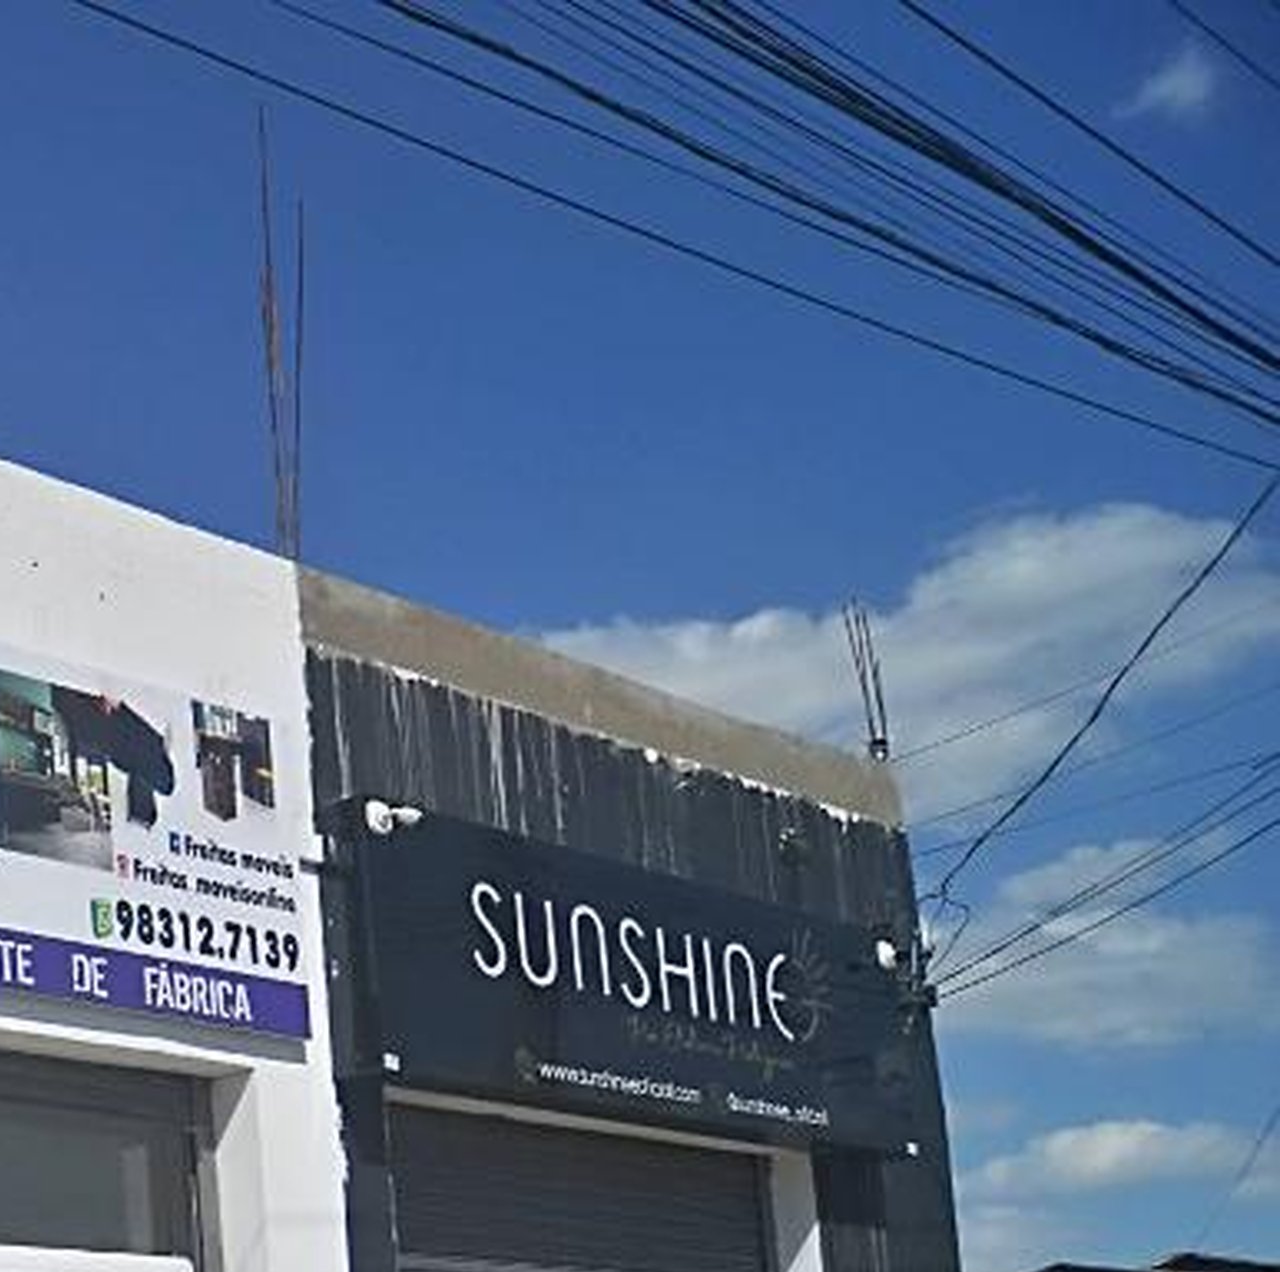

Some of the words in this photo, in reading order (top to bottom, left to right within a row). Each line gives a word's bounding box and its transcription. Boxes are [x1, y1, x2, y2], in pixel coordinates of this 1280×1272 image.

[71, 952, 108, 1000] DE
[143, 960, 252, 1022] FÁBRICA
[471, 882, 795, 1042] SUNSHINE
